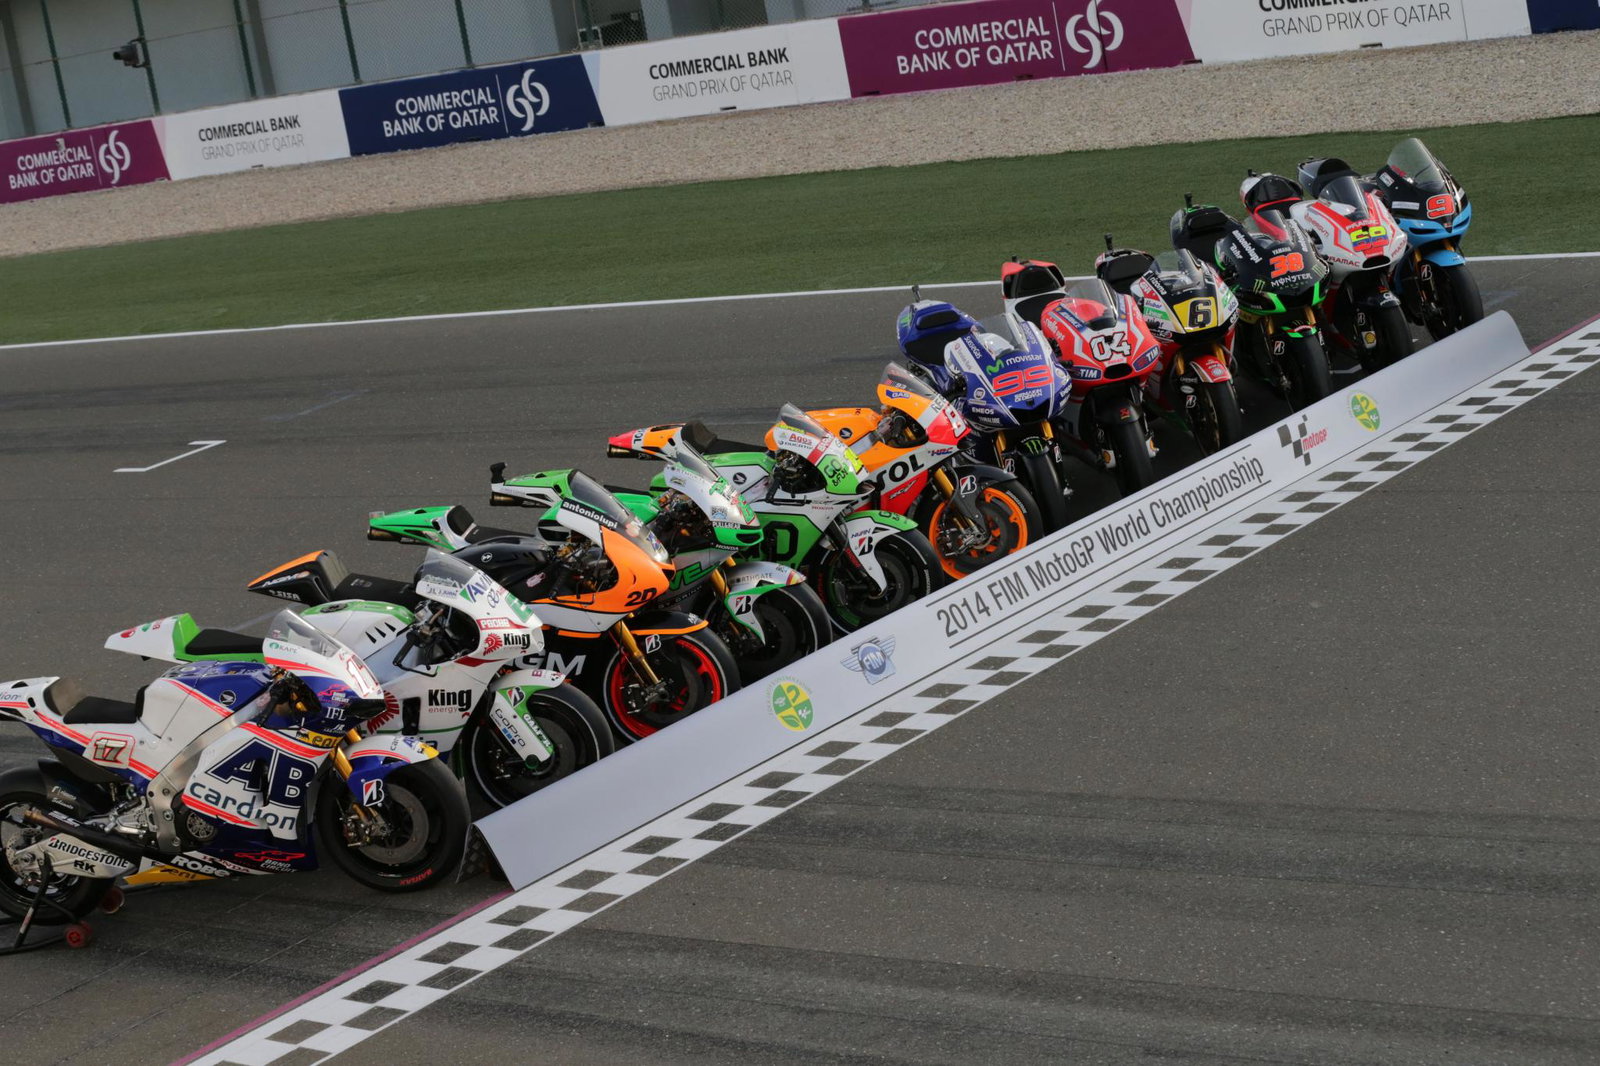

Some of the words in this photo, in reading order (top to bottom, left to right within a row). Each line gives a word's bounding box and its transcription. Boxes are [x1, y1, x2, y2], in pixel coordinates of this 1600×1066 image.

[915, 16, 1050, 50] COMMERCIAL
[1262, 14, 1323, 37] GRAND
[1325, 10, 1365, 32] PRIX
[1366, 7, 1390, 28] OF
[1393, 2, 1452, 27] QATAR
[649, 53, 745, 80] COMMERCIAL
[747, 47, 790, 68] BANK
[896, 50, 952, 75] BANK
[955, 47, 981, 68] OF
[986, 39, 1055, 66] QATAR
[653, 81, 698, 102] GRAND
[700, 79, 728, 96] PRIX
[730, 75, 747, 92] OF
[750, 69, 793, 91] QATAR
[395, 86, 496, 116] COMMERCIAL
[198, 119, 268, 142] COMMERCIAL
[269, 115, 301, 132] BANK
[382, 116, 424, 137] BANK
[426, 113, 445, 132] OF
[448, 106, 500, 129] QATAR
[17, 145, 92, 171] COMMERCIAL
[201, 143, 235, 160] GRAND
[236, 140, 257, 156] PRIX
[258, 138, 270, 153] OF
[272, 133, 304, 152] QATAR
[9, 170, 40, 189] BANK
[40, 168, 55, 184] OF
[57, 162, 95, 182] QATAR
[1426, 193, 1455, 220] 9
[1269, 252, 1305, 279] 38
[1270, 272, 1313, 287] MONSTER
[1188, 299, 1212, 329] 6
[1005, 353, 1043, 366] movistar
[1089, 331, 1132, 362] 04
[992, 364, 1055, 398] 99
[1080, 369, 1098, 379] TIM
[971, 407, 995, 415] ENEOS
[823, 458, 843, 478] GO
[562, 500, 618, 529] antoniolupi
[936, 591, 991, 638] 2014
[987, 571, 1030, 611] FIM
[1025, 535, 1095, 592] MotoGP
[1095, 508, 1152, 555] World
[1149, 455, 1265, 529] Championship
[503, 633, 531, 649] King
[863, 650, 886, 671] FIM
[325, 707, 347, 721] IFL
[428, 689, 472, 713] King
[428, 705, 459, 714] energy
[312, 734, 340, 748] eni
[494, 708, 526, 747] GoPro
[93, 737, 128, 763] 17
[205, 737, 319, 809] AB
[189, 782, 297, 831] cardion
[48, 837, 129, 869] BRIDGESTONE
[74, 860, 96, 873] RK
[168, 868, 196, 880] eni
